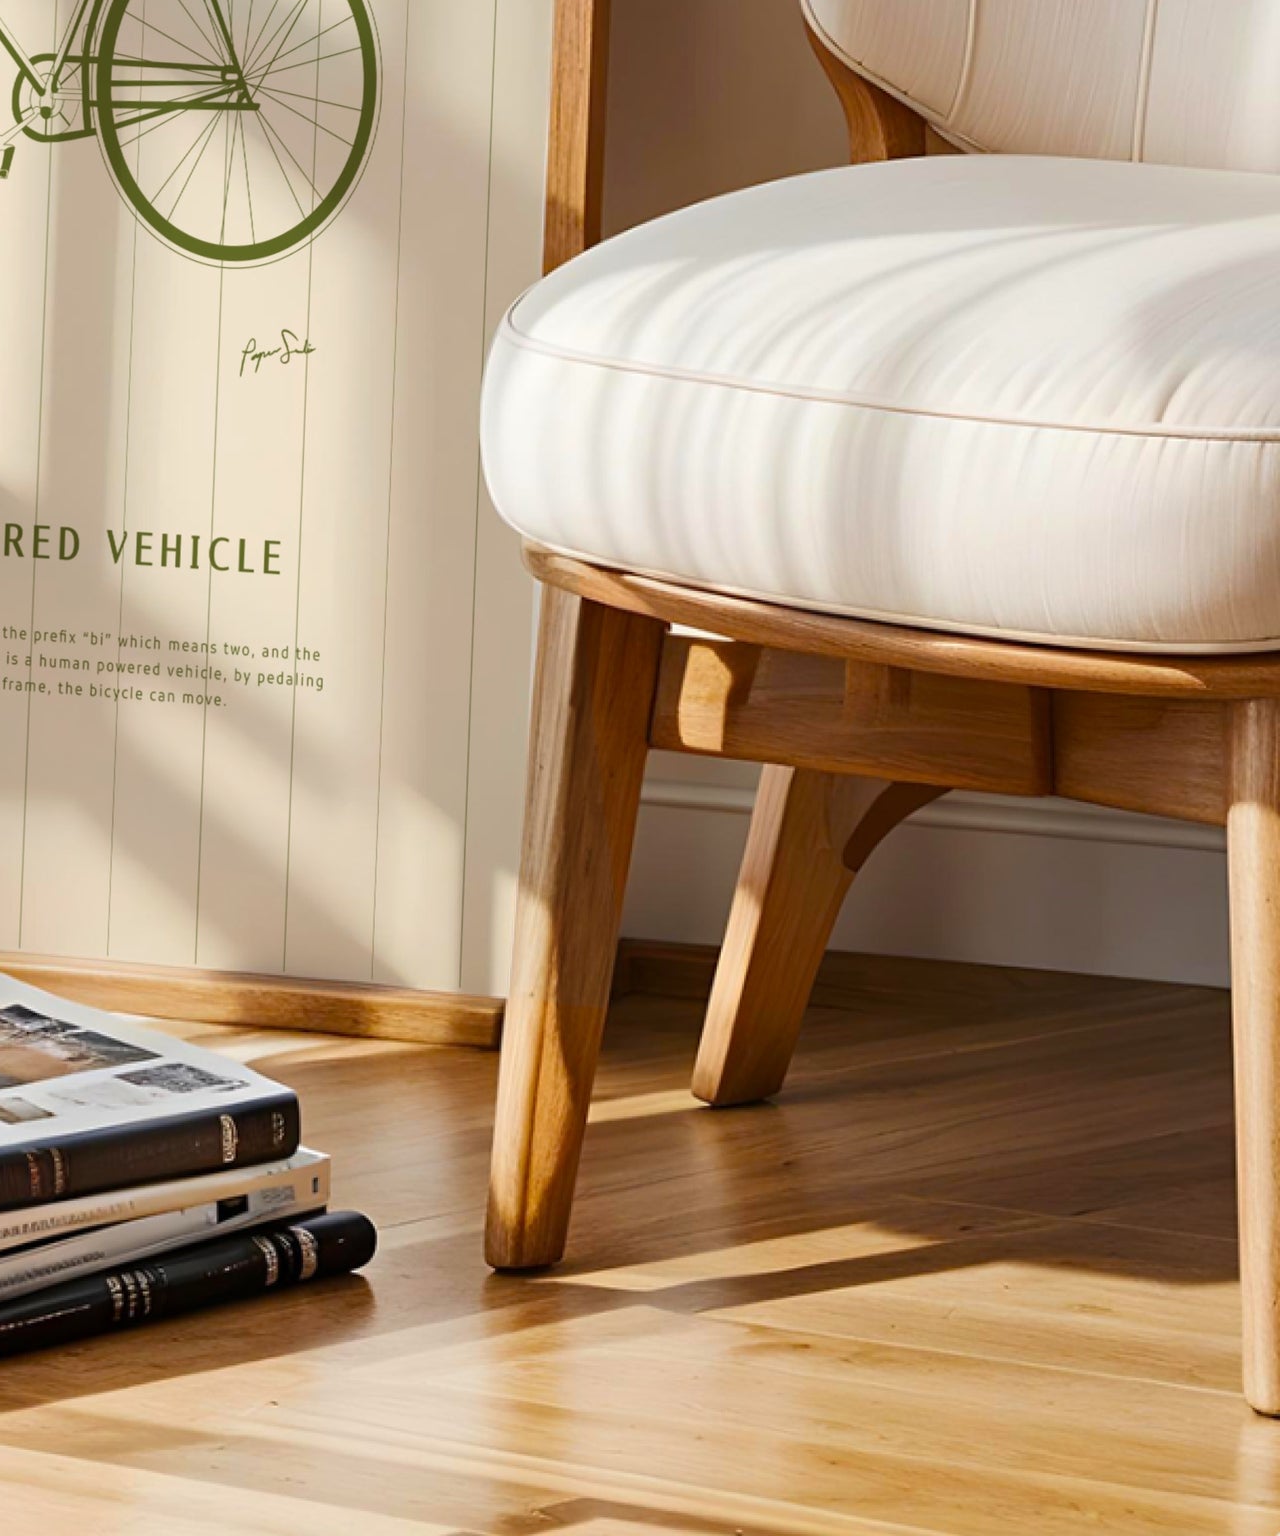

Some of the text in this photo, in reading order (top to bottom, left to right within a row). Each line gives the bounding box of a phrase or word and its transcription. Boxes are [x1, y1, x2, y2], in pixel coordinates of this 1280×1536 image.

[106, 529, 281, 575] VEHICLE
[2, 626, 27, 640] the
[33, 629, 77, 645] prefix
[117, 633, 161, 650] which
[168, 639, 217, 654] means
[223, 642, 255, 659] two,
[261, 645, 289, 660] and
[295, 647, 321, 662] the
[6, 651, 19, 666] is
[24, 655, 32, 667] a
[39, 654, 90, 671] human
[96, 660, 160, 676] powered
[167, 665, 227, 683] vehicle,
[234, 668, 251, 684] by
[257, 671, 324, 691] pedaling
[2, 677, 52, 696] frame,
[58, 681, 83, 696] the
[89, 683, 143, 702] bicycle
[149, 689, 175, 703] can
[182, 691, 227, 707] move.
